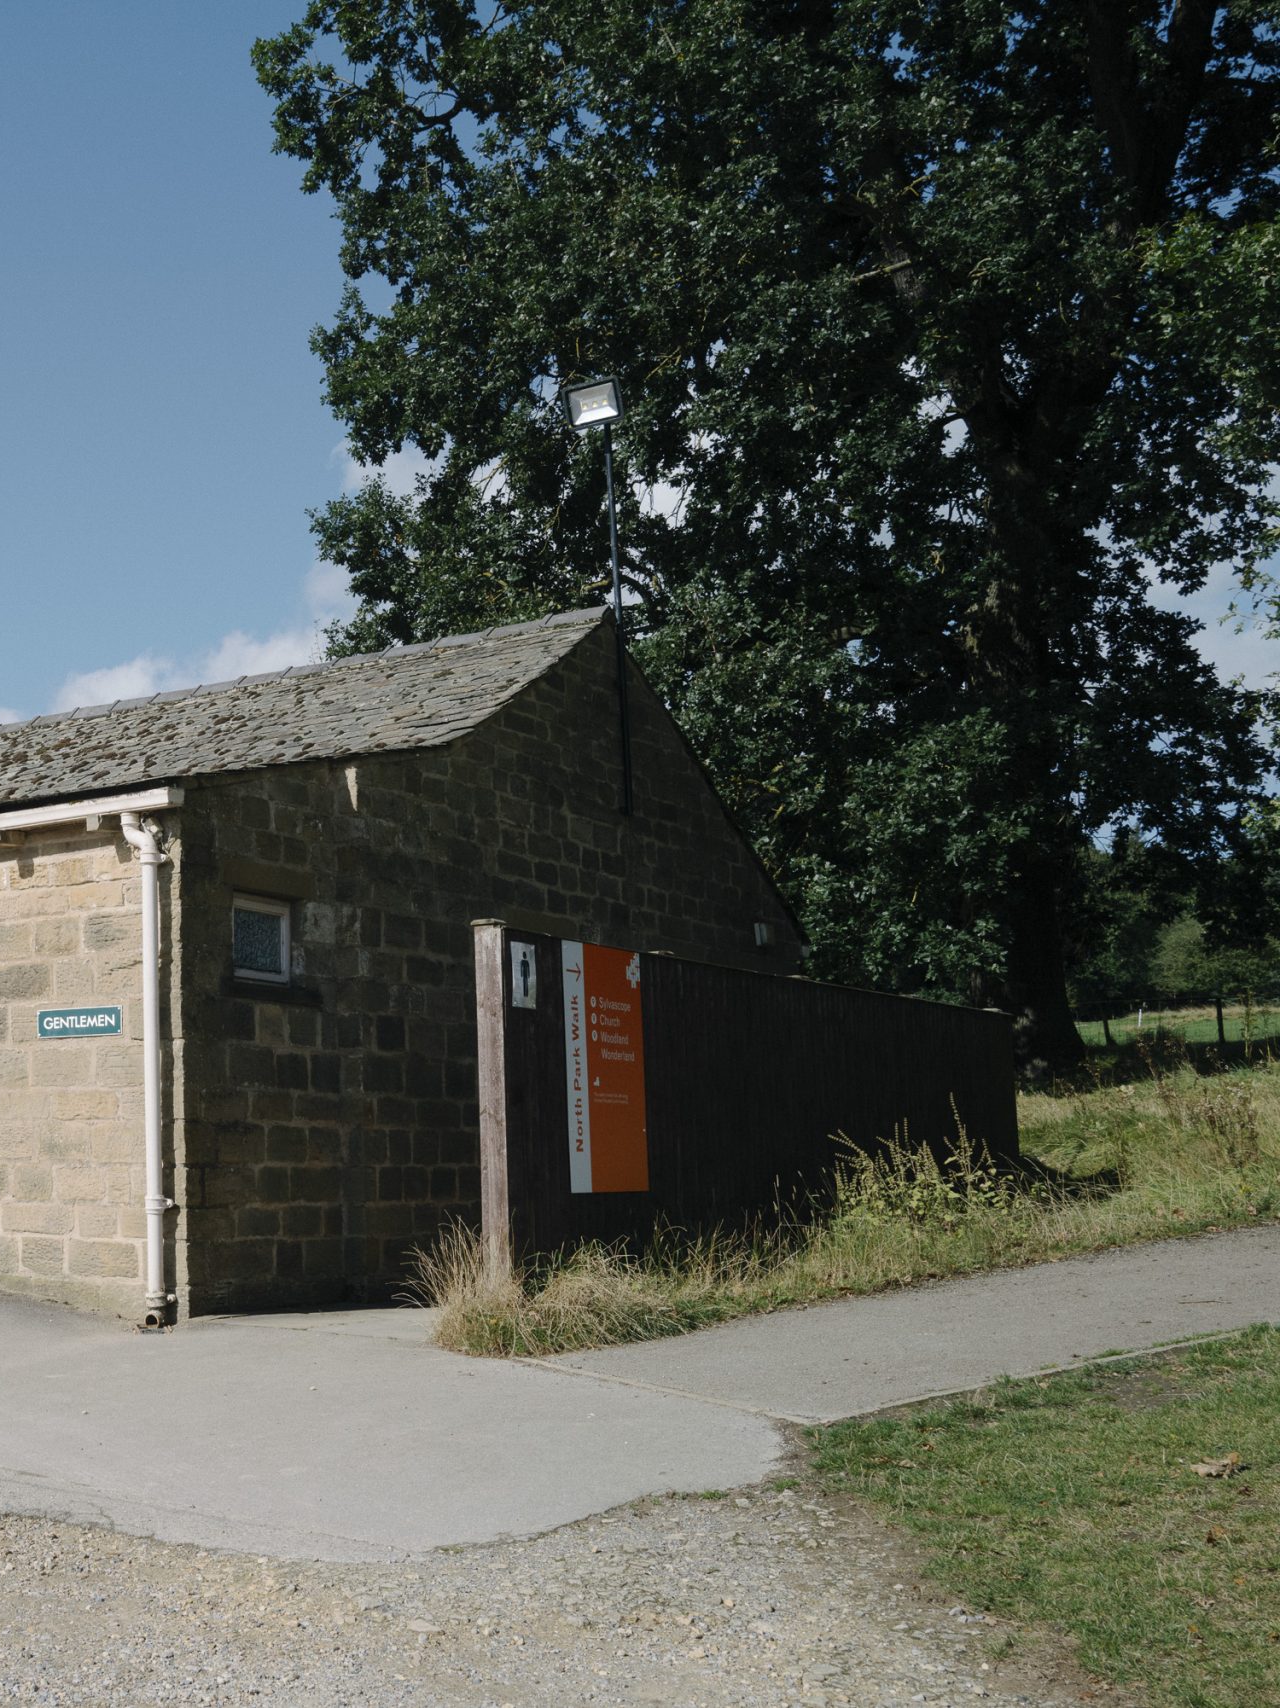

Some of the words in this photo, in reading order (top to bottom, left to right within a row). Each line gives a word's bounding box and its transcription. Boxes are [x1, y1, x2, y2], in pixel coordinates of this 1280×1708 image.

[599, 997, 631, 1012] Sylvascope
[43, 1014, 115, 1030] GENTLEMEN
[571, 994, 579, 1041] Walk
[600, 1014, 620, 1026] Church
[601, 1032, 629, 1045] Woodland
[601, 1048, 635, 1061] Wonderland
[573, 1047, 582, 1091] Park
[575, 1097, 584, 1153] North
